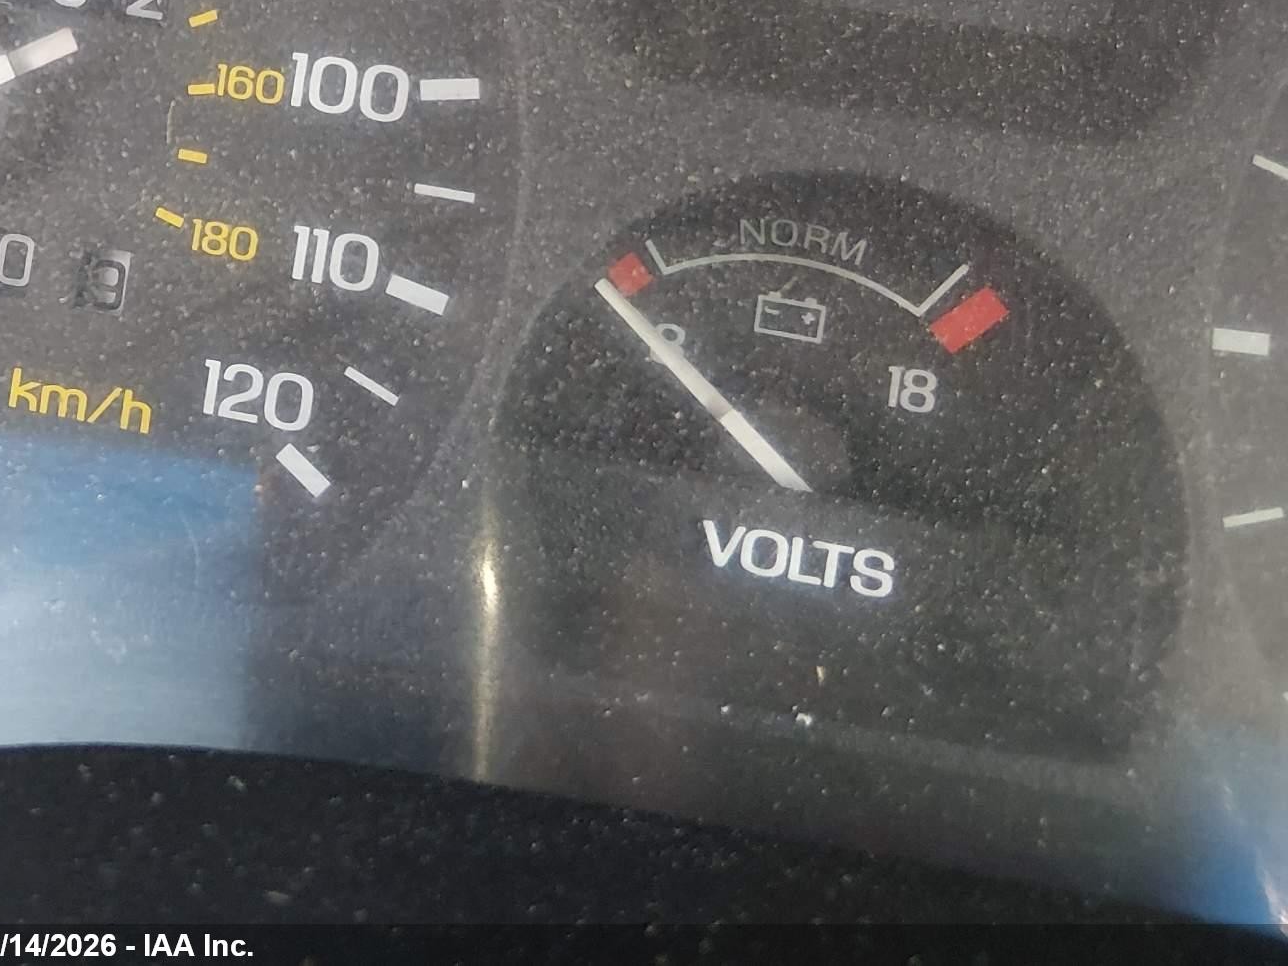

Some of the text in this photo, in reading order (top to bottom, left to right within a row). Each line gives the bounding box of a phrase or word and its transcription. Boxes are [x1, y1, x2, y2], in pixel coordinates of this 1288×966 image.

[217, 63, 286, 106] 160
[290, 52, 410, 123] 100
[191, 217, 259, 263] 180
[291, 225, 380, 293] 110
[738, 218, 868, 266] NORM
[7, 366, 153, 434] km/h
[202, 359, 315, 432] 120
[886, 365, 938, 414] 18
[702, 519, 897, 599] VOLTS
